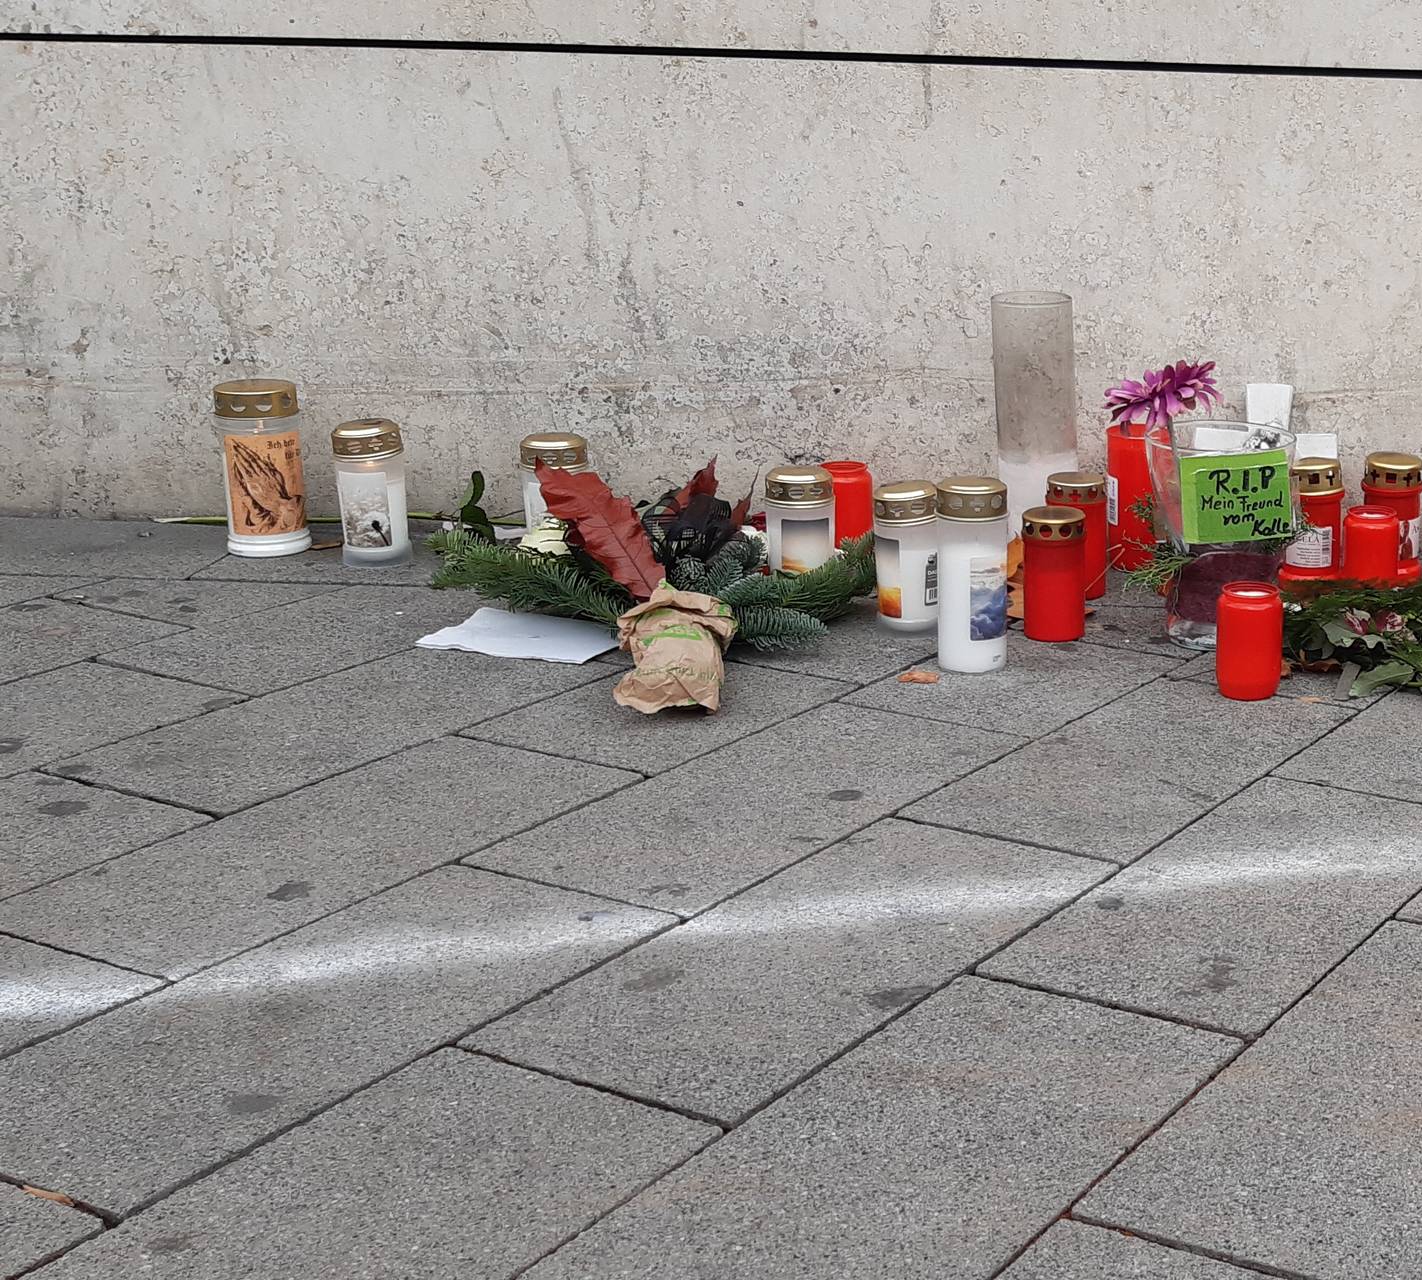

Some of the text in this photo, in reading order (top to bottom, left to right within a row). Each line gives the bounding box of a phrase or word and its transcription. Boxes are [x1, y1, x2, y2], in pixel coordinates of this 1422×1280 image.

[1208, 466, 1276, 495] R.I.P
[1201, 491, 1284, 512] Mein Freund
